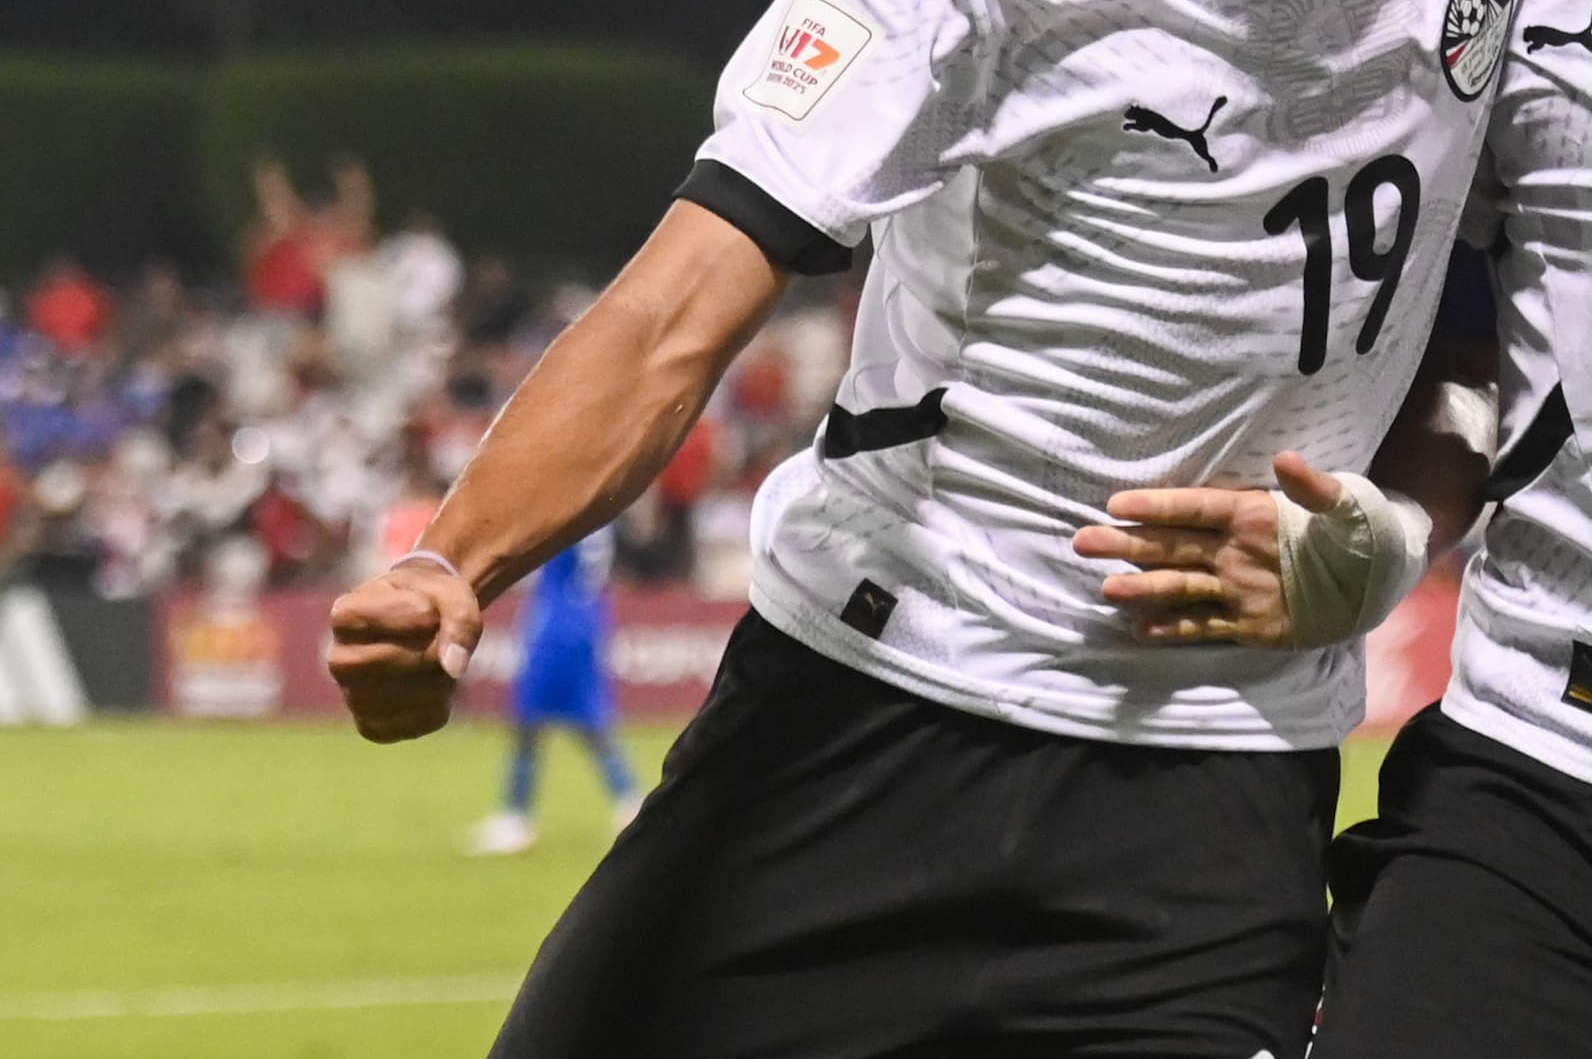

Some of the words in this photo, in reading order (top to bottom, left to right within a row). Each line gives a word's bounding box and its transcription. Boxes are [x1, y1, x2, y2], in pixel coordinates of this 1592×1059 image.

[801, 18, 827, 37] FIFA
[793, 68, 818, 86] CUP
[1263, 154, 1421, 375] 19
